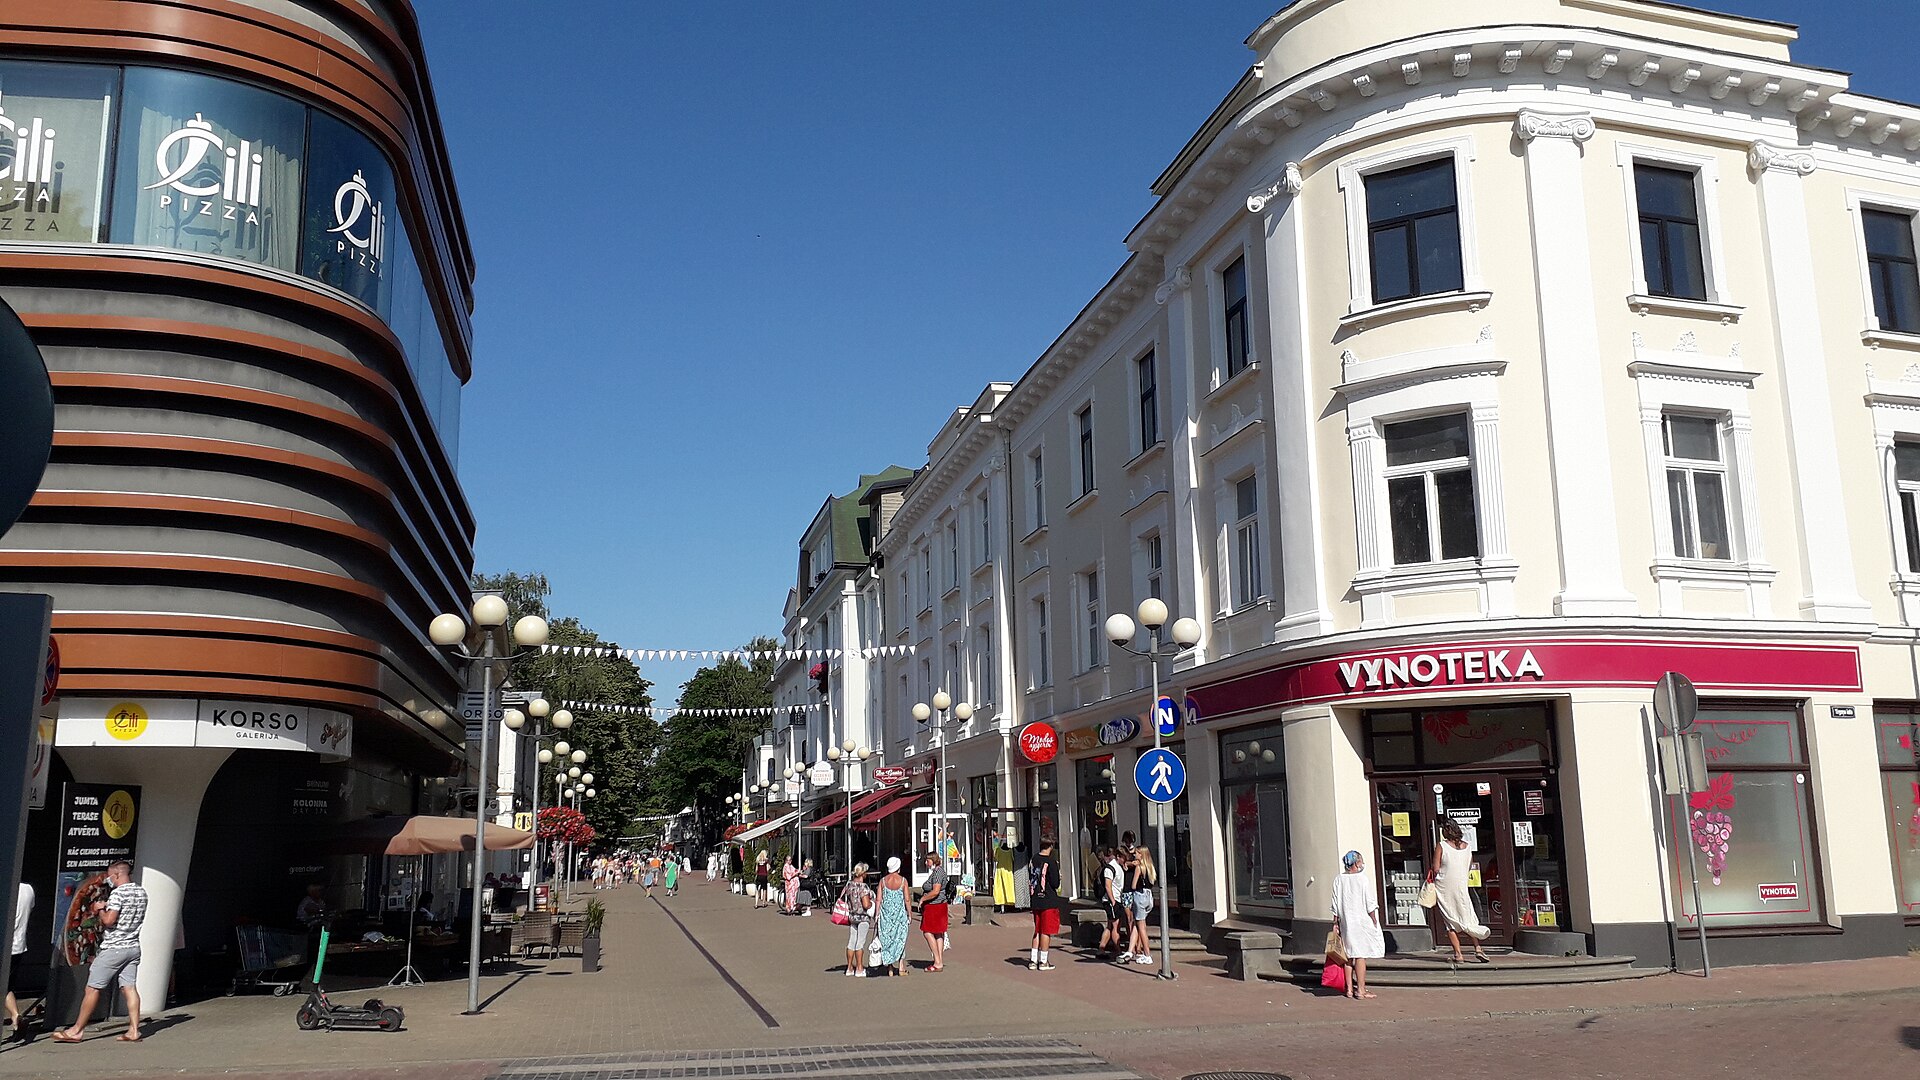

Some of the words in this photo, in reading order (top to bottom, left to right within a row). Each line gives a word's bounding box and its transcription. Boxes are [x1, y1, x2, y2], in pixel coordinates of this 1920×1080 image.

[0, 98, 56, 184] ili
[160, 195, 259, 225] PIZZA
[337, 241, 383, 280] PIZZA
[1338, 649, 1545, 688] VYNOTEKA
[213, 709, 298, 730] KORSO
[1158, 707, 1174, 725] N
[235, 731, 279, 740] GALERIJA
[74, 796, 98, 805] JUMTA
[293, 799, 327, 808] KOLONNA
[72, 812, 99, 821] TERASE
[68, 825, 99, 836] ATVĒRTA
[1760, 888, 1796, 896] VYNOTEKA
